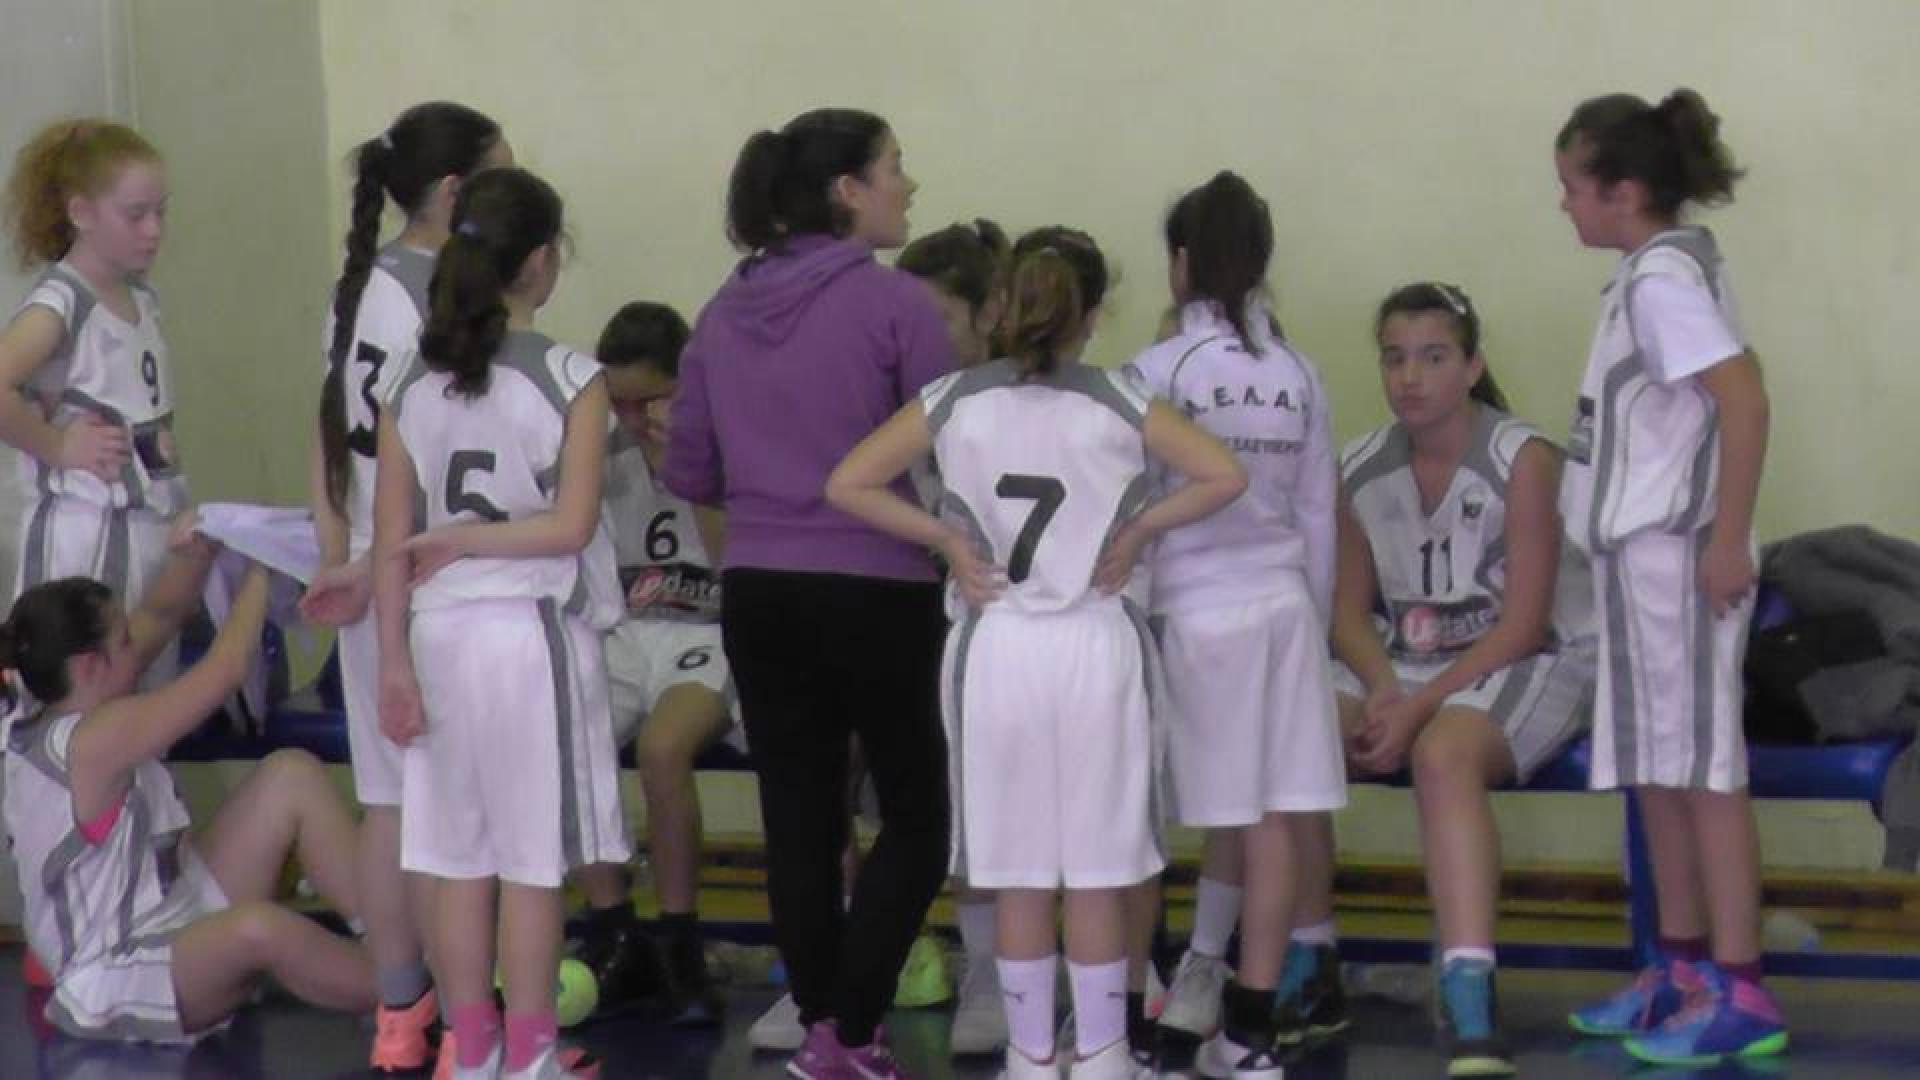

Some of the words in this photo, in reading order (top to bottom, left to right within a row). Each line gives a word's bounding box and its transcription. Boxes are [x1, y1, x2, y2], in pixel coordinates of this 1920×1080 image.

[141, 349, 160, 407] 9
[347, 339, 388, 459] 3
[446, 449, 511, 523] 5
[644, 510, 680, 562] 6
[995, 472, 1067, 585] 7
[1418, 536, 1454, 597] 11
